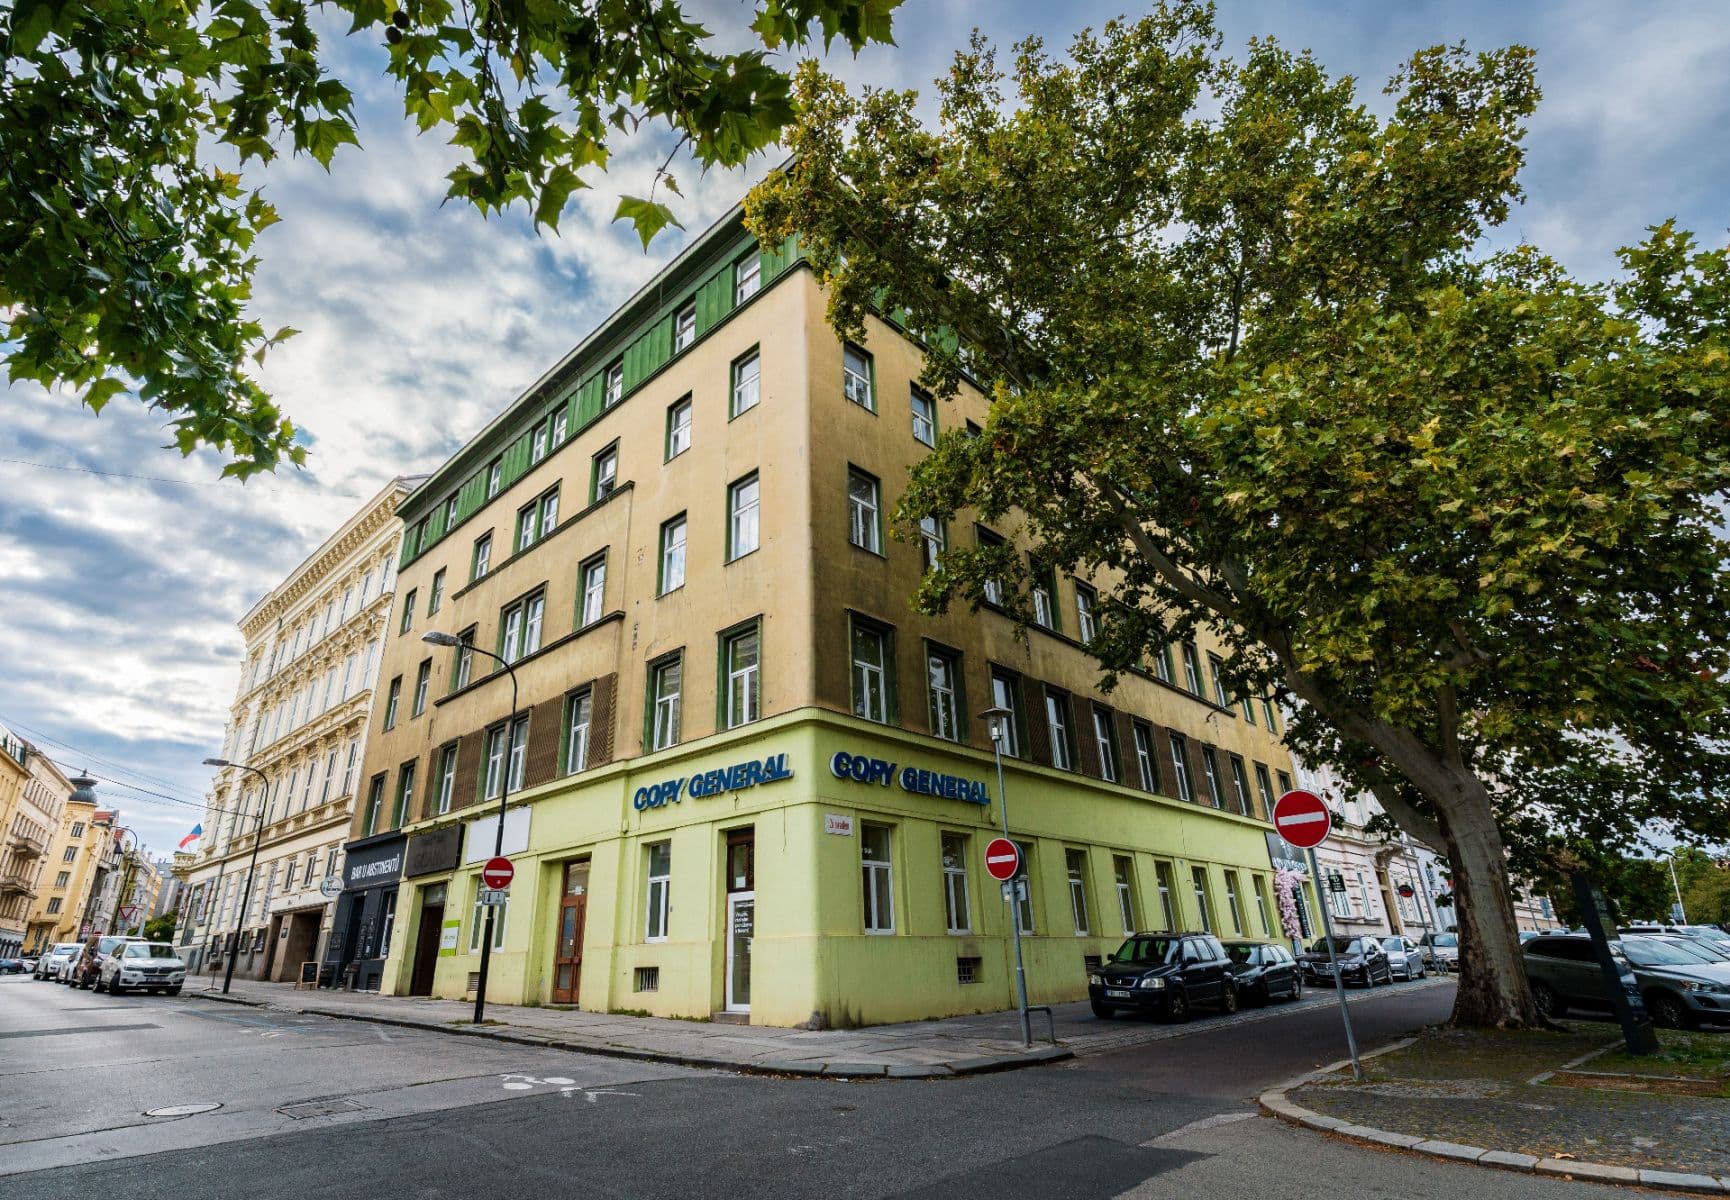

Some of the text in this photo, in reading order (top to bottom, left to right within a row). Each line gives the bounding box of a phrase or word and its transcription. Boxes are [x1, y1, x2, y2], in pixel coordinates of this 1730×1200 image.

[634, 753, 793, 810] COPY GENERAL
[830, 751, 991, 805] COPY GENERAL
